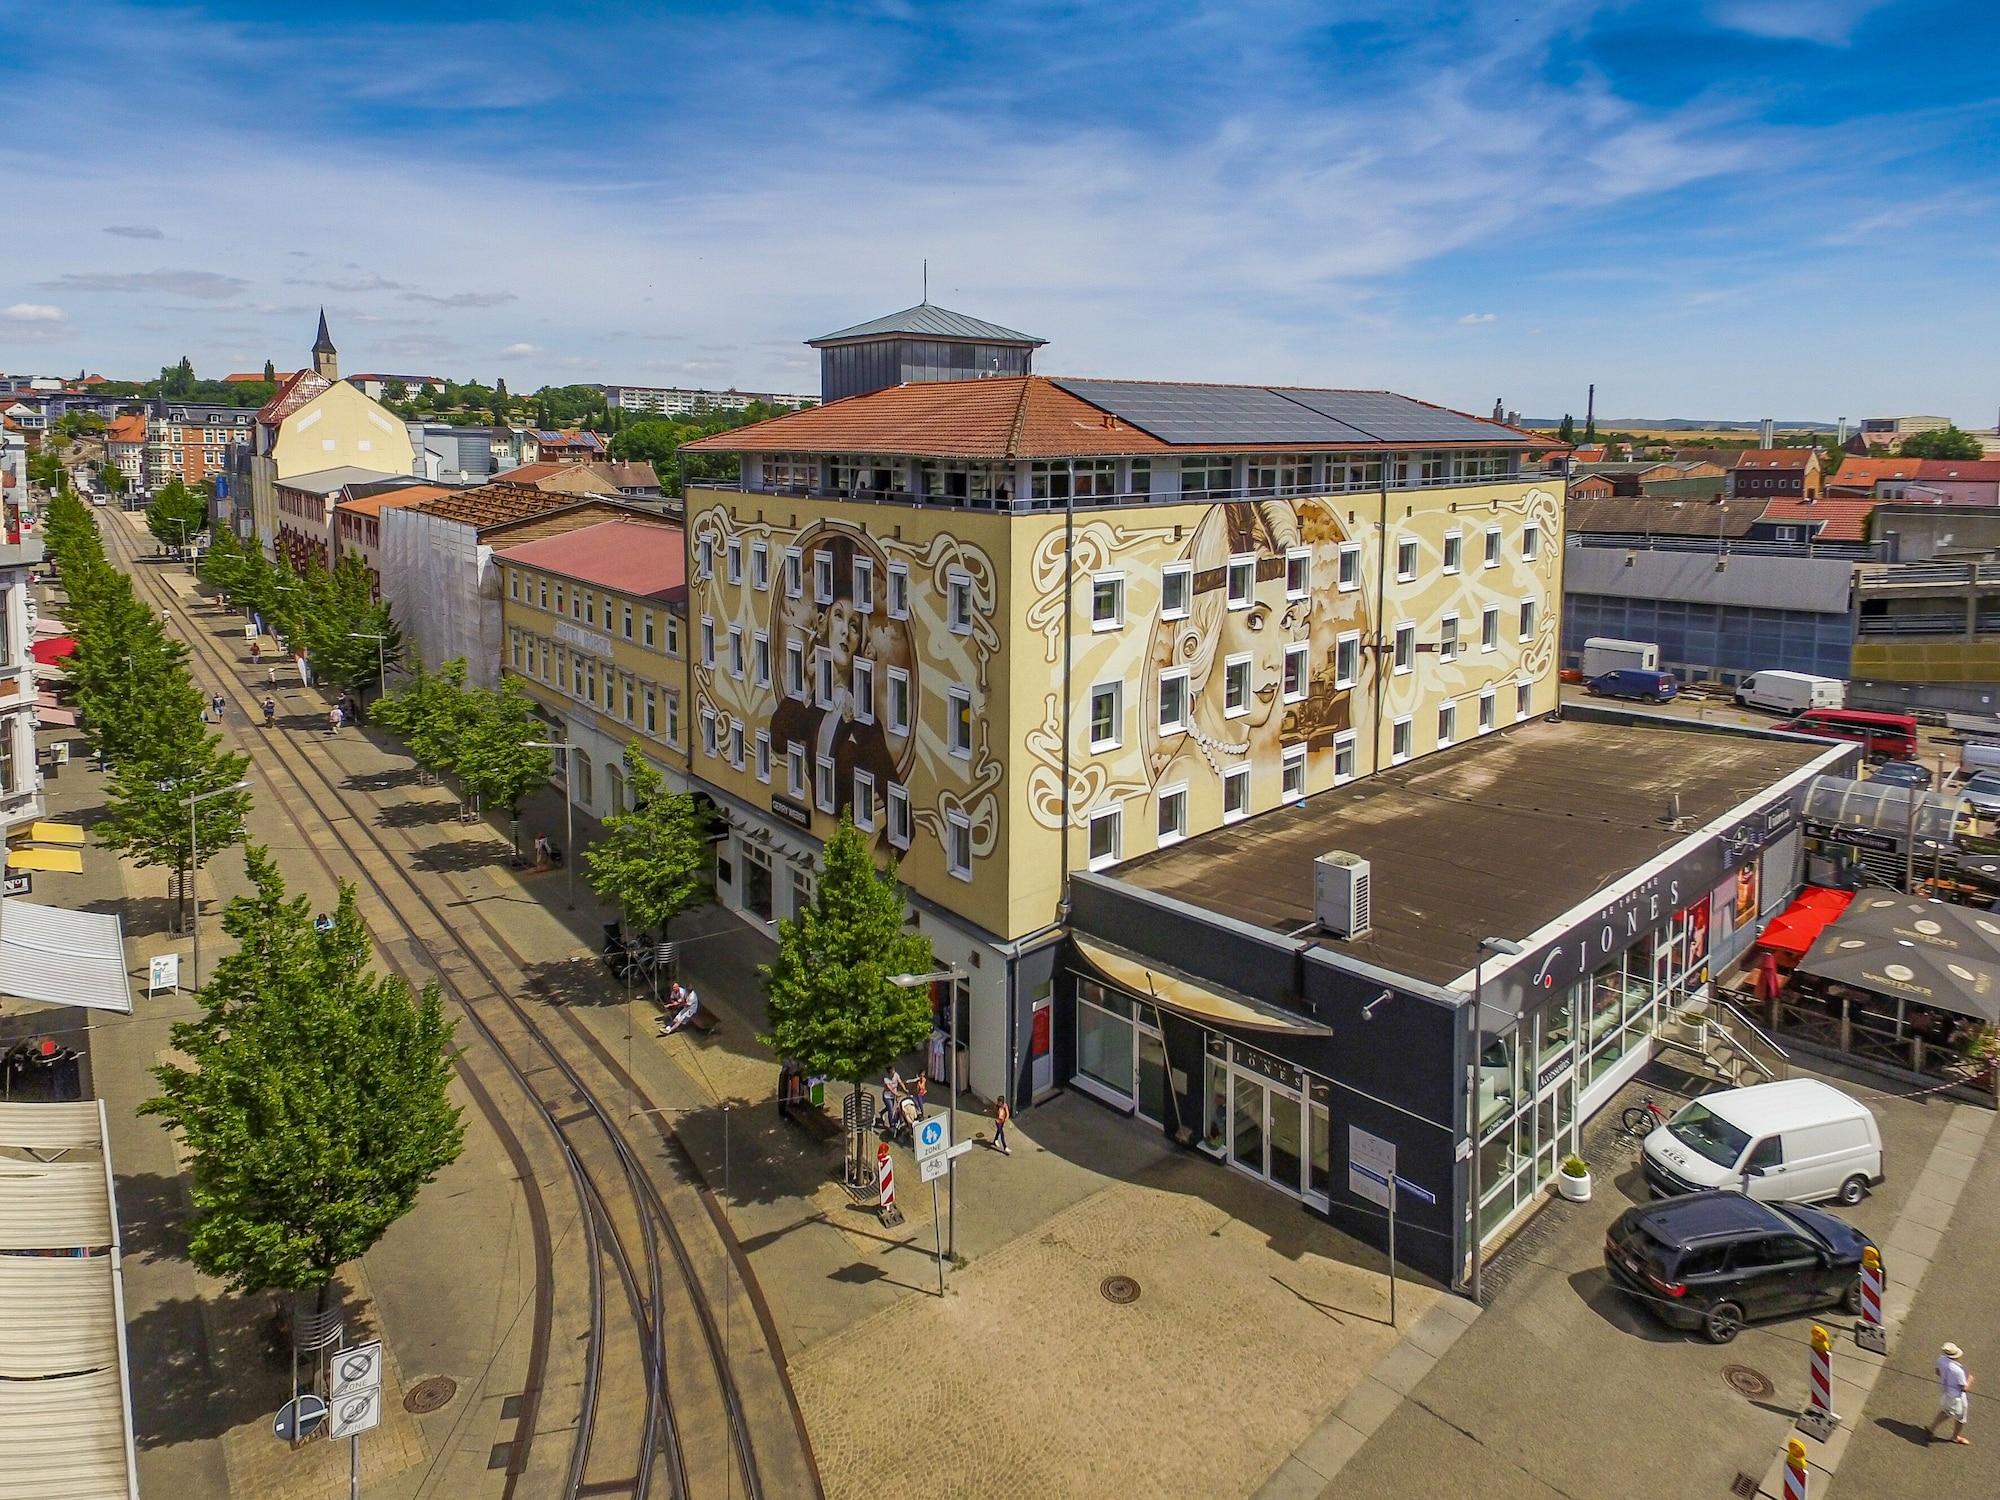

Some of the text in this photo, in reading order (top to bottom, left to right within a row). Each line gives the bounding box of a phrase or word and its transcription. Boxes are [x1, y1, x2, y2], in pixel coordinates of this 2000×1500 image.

[1579, 880, 1679, 973] JONES
[1601, 876, 1658, 919] BE THE ONE
